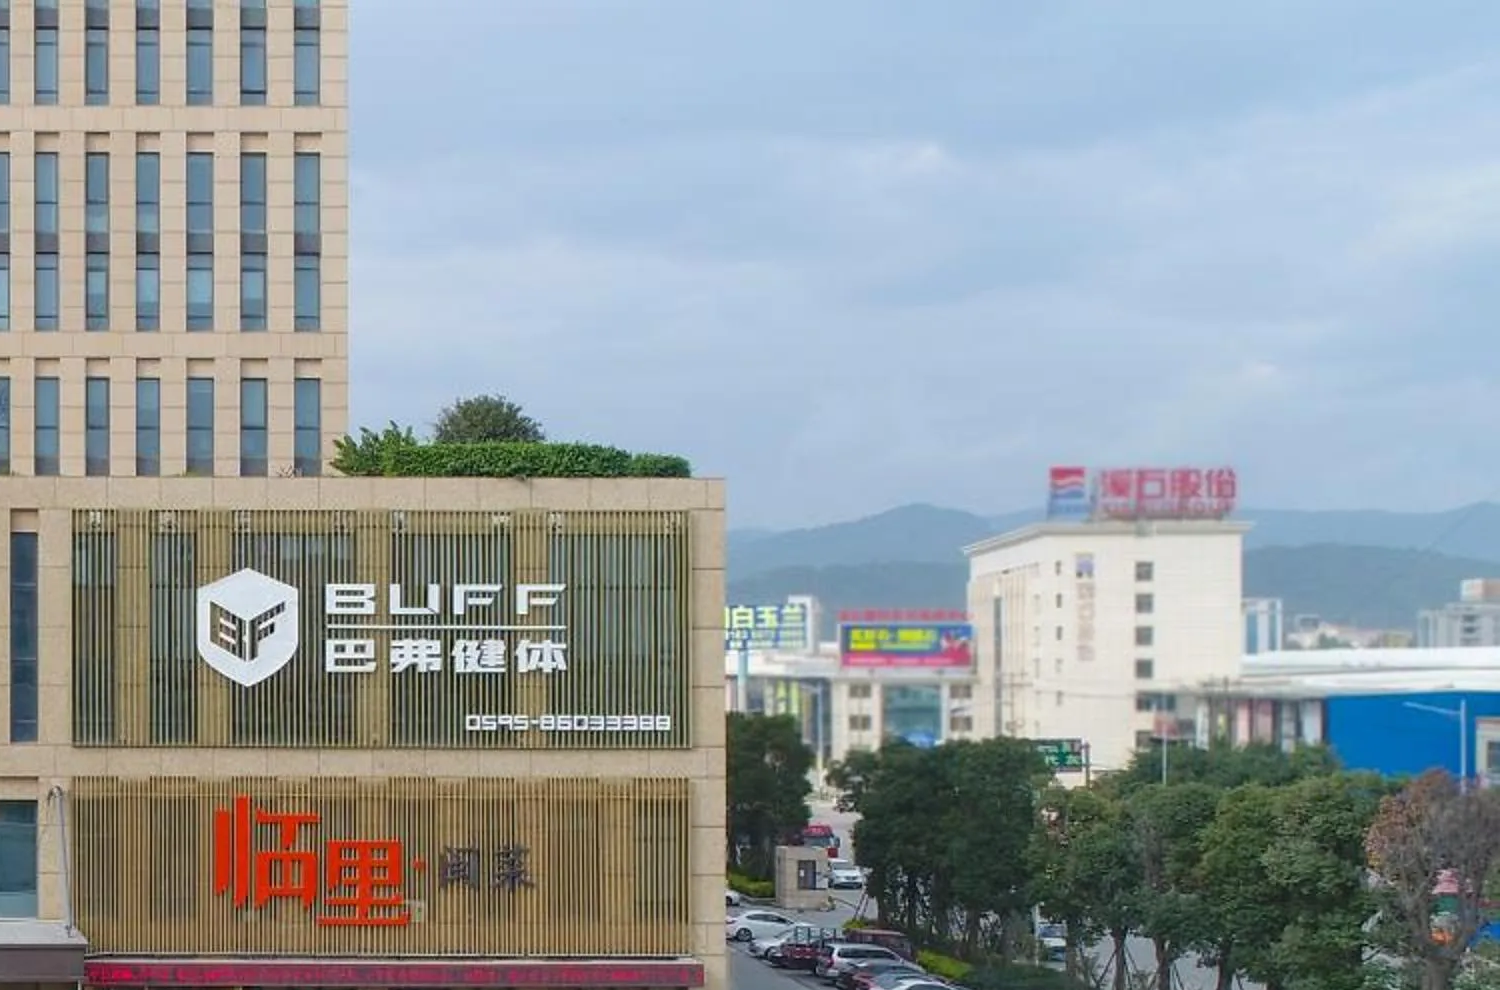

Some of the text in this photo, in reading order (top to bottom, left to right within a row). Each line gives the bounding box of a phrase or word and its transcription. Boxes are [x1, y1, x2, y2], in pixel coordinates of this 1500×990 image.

[325, 583, 568, 614] BUFF
[724, 604, 805, 629] 白玉兰
[325, 639, 568, 674] 巴弗健体
